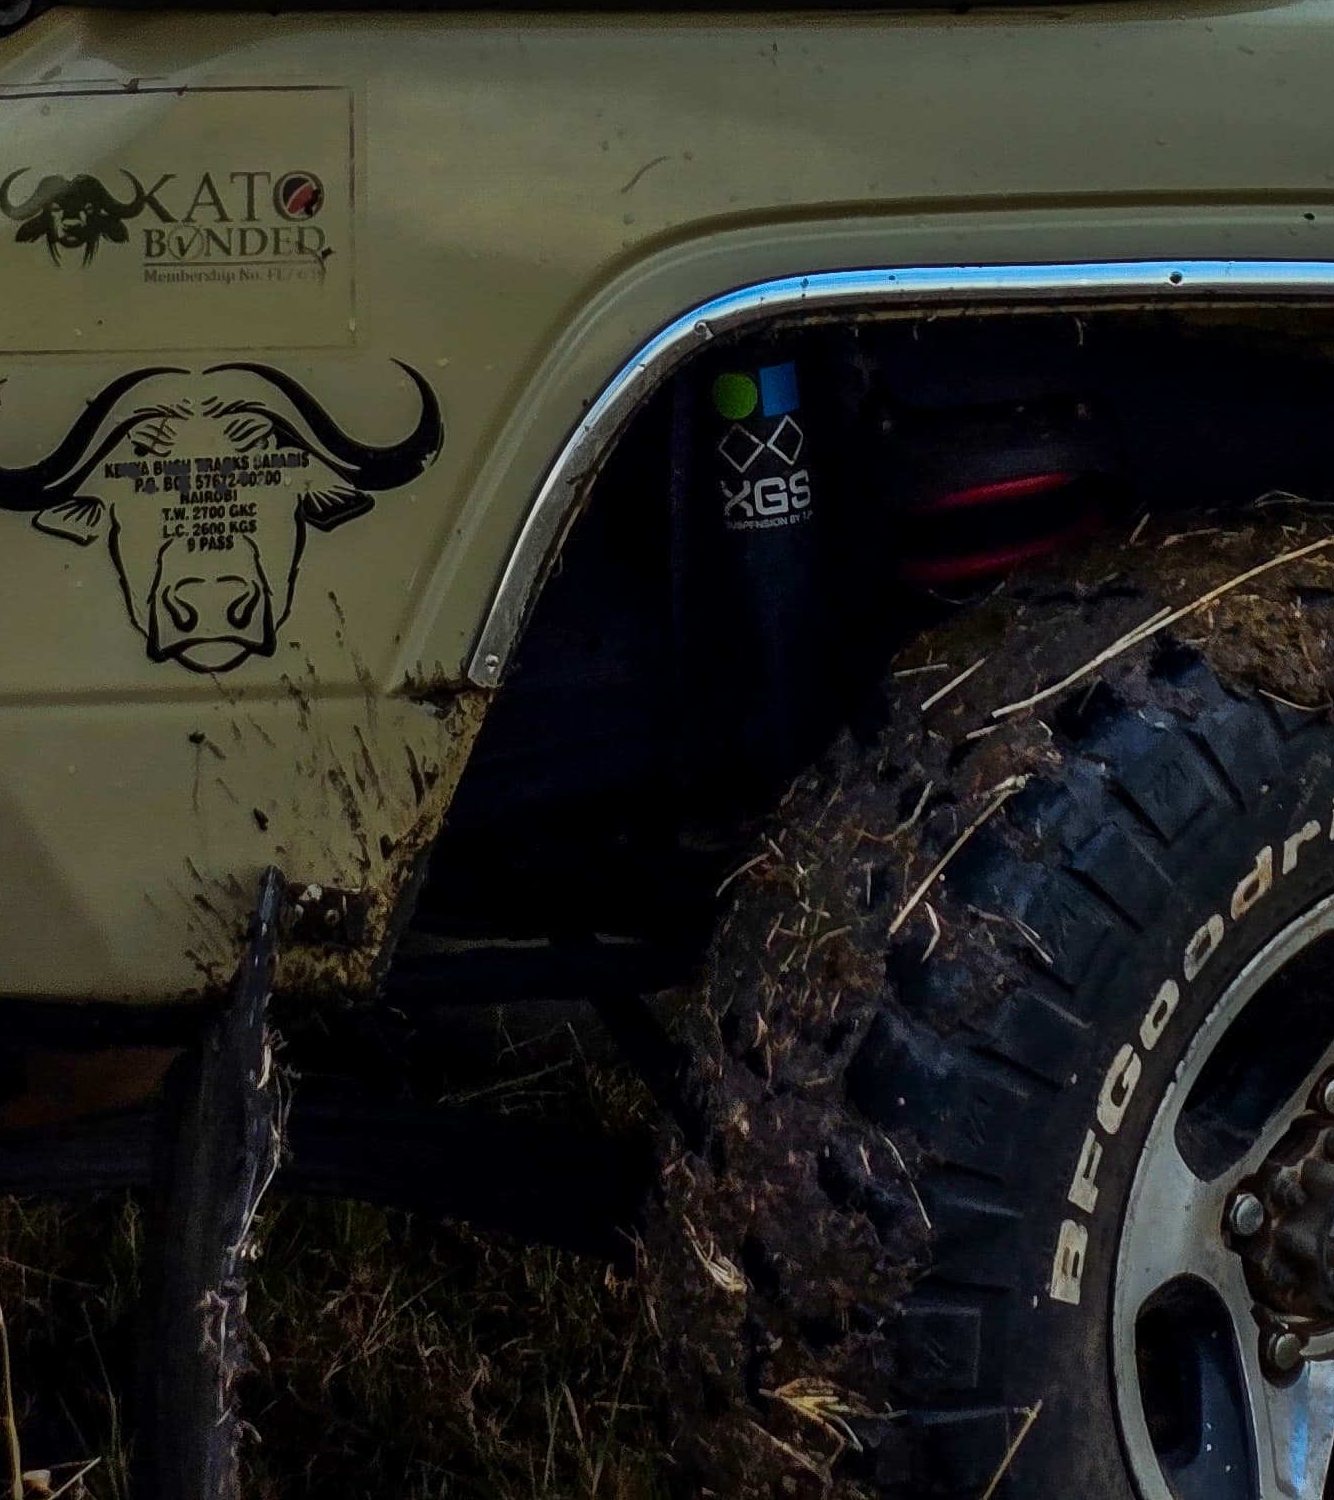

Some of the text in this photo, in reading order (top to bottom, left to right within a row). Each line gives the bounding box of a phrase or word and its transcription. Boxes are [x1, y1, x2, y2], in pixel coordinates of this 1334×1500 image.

[138, 169, 325, 223] KATO
[179, 488, 238, 504] NAIROBI
[720, 469, 812, 518] XGS
[192, 505, 225, 520] 2700
[229, 519, 257, 535] KGS
[199, 535, 234, 552] PASS
